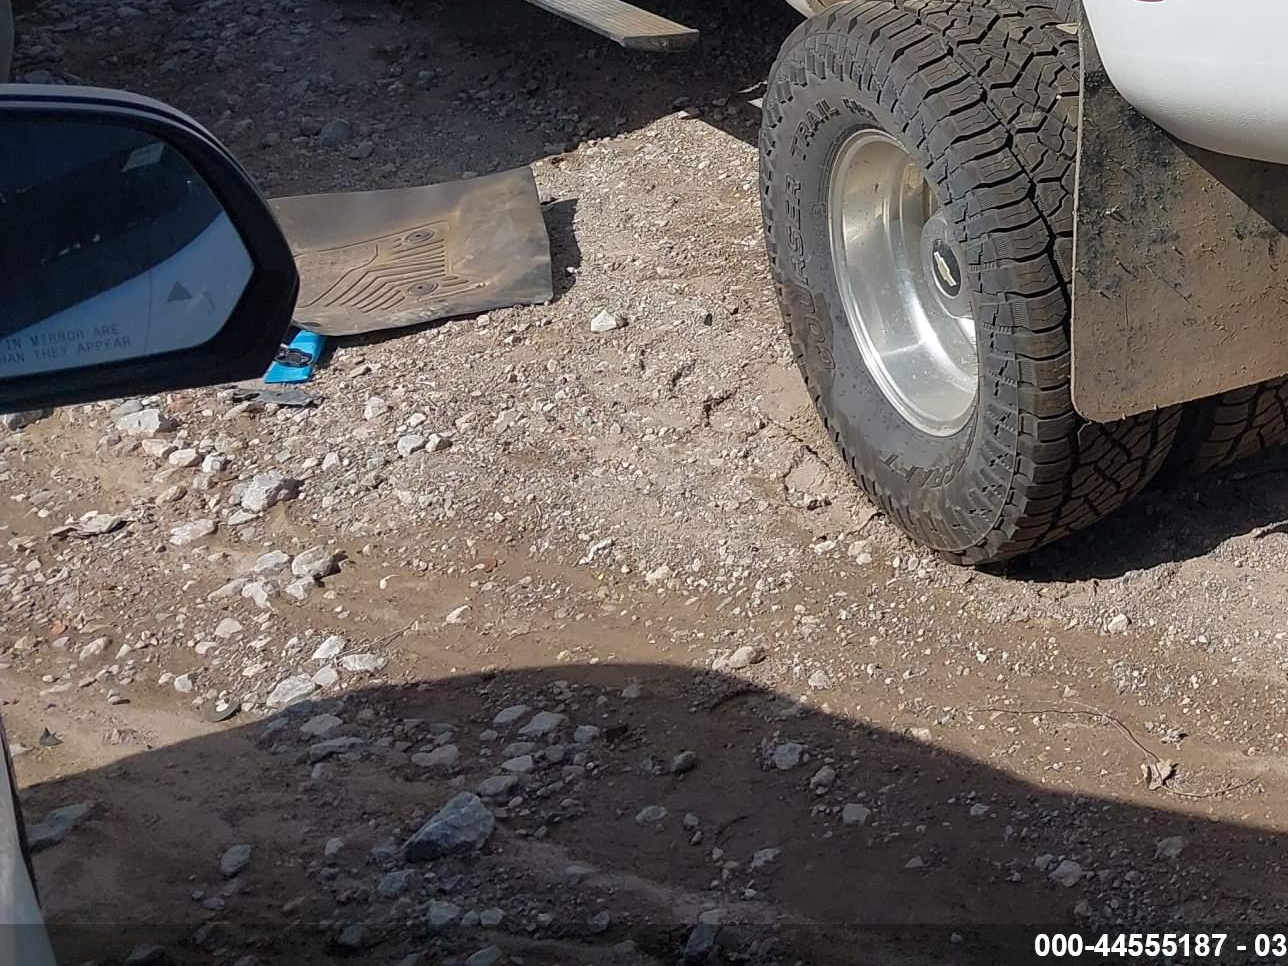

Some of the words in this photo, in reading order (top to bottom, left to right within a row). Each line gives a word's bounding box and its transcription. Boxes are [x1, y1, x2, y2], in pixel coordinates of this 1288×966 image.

[790, 97, 841, 162] TRAIL
[5, 337, 23, 351] IN
[29, 329, 85, 347] MIRROR
[92, 323, 120, 338] ARE
[33, 345, 68, 361] THEY
[77, 336, 132, 355] APPEAR
